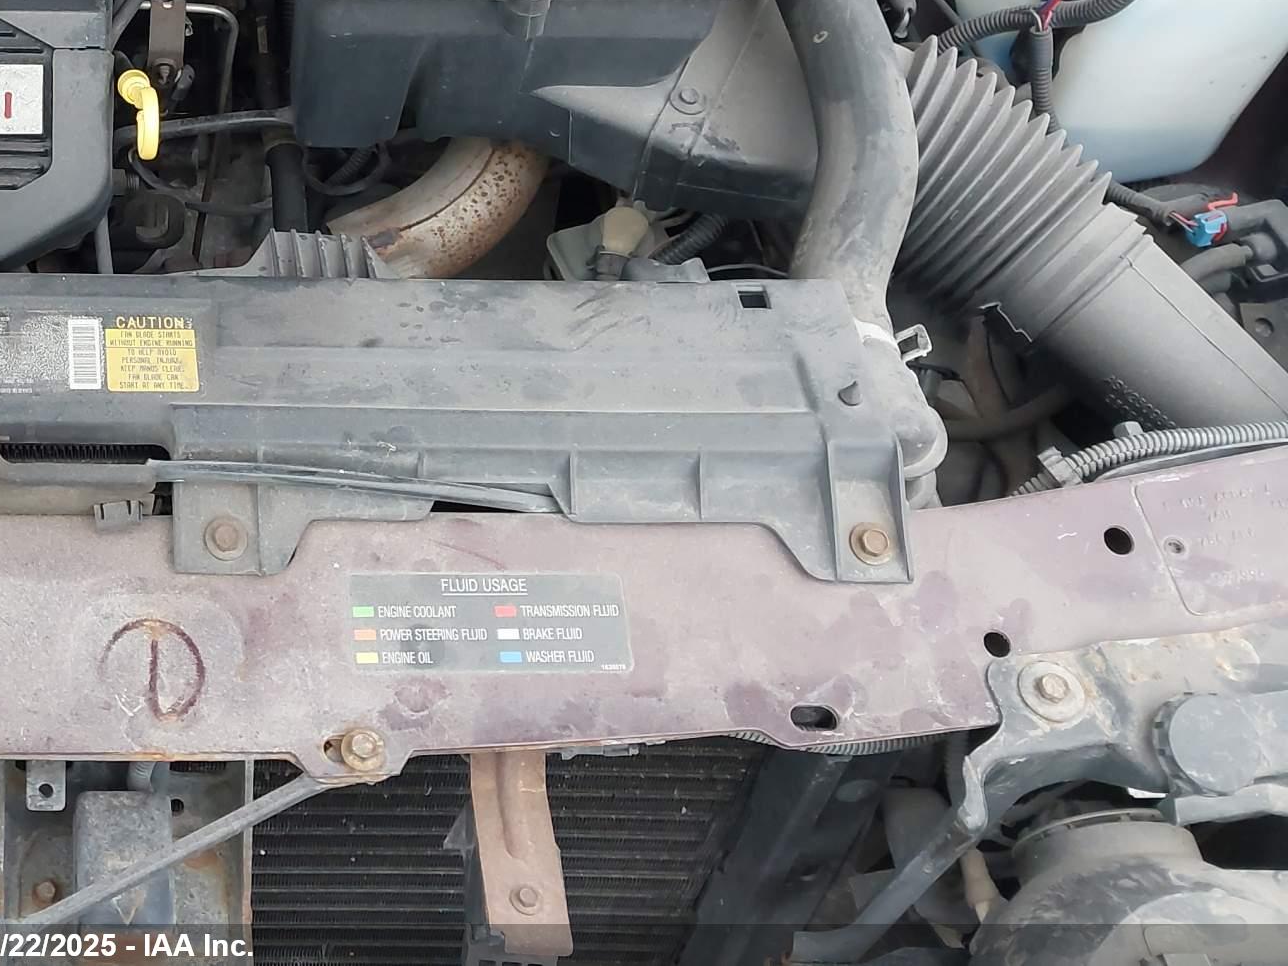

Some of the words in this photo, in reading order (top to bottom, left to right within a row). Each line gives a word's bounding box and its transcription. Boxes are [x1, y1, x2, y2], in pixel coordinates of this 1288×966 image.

[140, 339, 162, 347] ENGINE
[166, 339, 193, 347] RUNNING
[441, 578, 477, 592] FLUID
[482, 578, 527, 592] USAGE
[377, 606, 412, 618] ENGINE
[414, 605, 457, 618] COOLANT
[520, 605, 590, 617] TRANSMISSION
[593, 605, 619, 617] FLUID
[380, 629, 412, 641] POWER
[414, 629, 459, 641] STEERING
[462, 629, 488, 641] FLUID
[523, 628, 555, 640] BRAKE
[557, 628, 582, 640] FLUID
[382, 652, 416, 664] ENGINE
[418, 652, 433, 664] OIL
[526, 651, 565, 663] WASHER
[568, 651, 594, 663] FLUID
